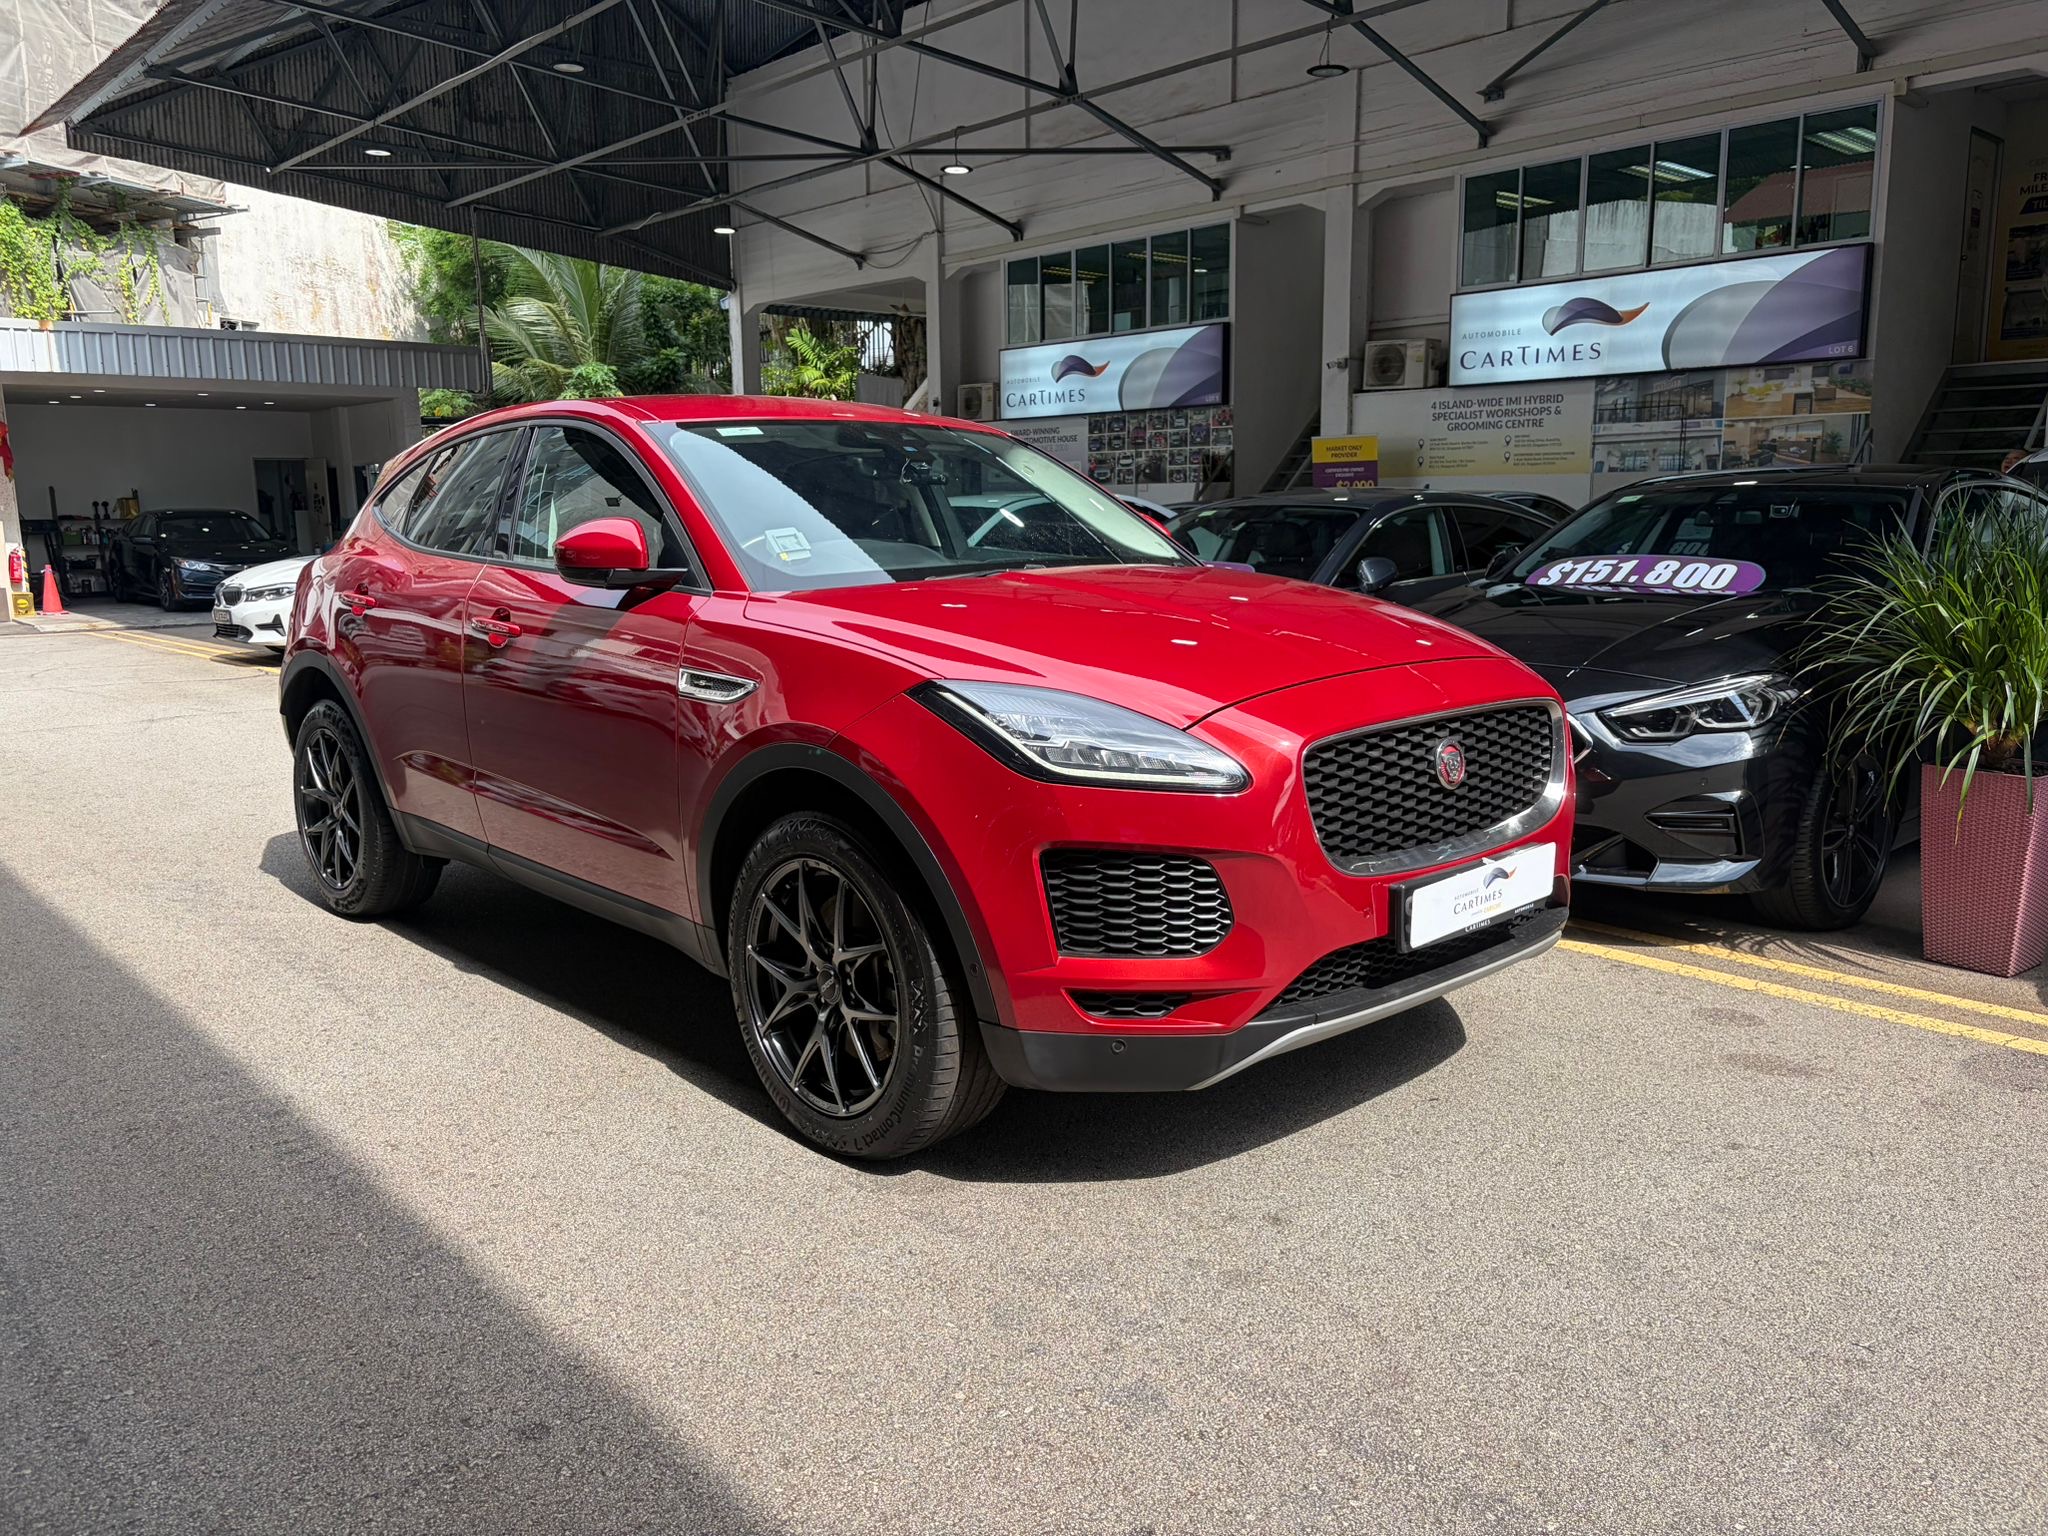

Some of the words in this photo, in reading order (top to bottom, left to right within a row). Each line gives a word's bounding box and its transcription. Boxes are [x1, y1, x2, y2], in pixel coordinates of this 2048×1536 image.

[1461, 328, 1522, 340] AUTOMOBILE
[1460, 342, 1602, 370] CARTIMES
[1829, 345, 1846, 354] LOT
[1006, 377, 1040, 385] AUTOMOBILE
[1006, 388, 1086, 408] CARTIMES
[1431, 401, 1437, 410] 4
[1438, 397, 1503, 410] ISLAND-WIDE
[1505, 397, 1521, 406] IMI
[1523, 393, 1564, 405] HYBRID
[1431, 409, 1484, 422] SPECIALIST
[1485, 407, 1552, 419] WORKSHOPS
[1554, 406, 1562, 415] &
[1447, 420, 1503, 432] GROOMING
[1505, 418, 1544, 429] CENTRE
[1024, 436, 1057, 444] TOMOTIVE
[1058, 434, 1078, 443] HOUSE
[1336, 480, 1374, 488] $2000
[1465, 919, 1491, 932] CARTIMES
